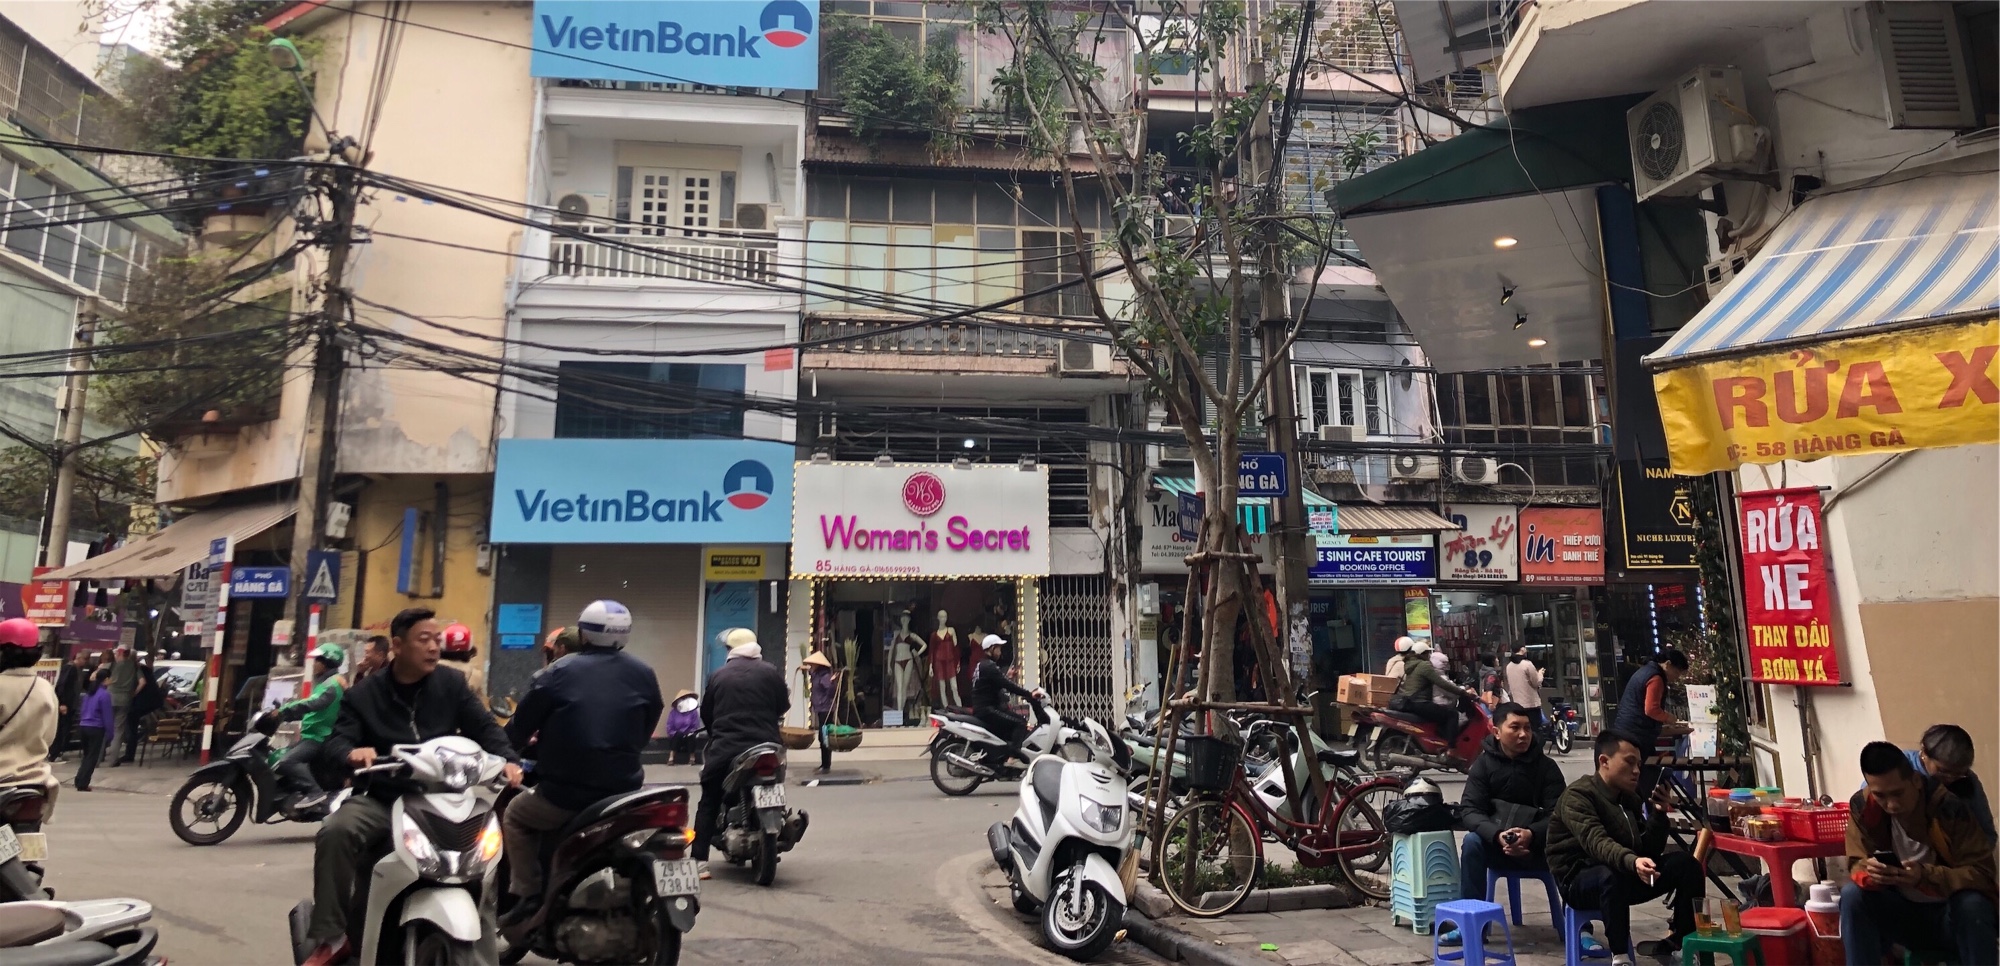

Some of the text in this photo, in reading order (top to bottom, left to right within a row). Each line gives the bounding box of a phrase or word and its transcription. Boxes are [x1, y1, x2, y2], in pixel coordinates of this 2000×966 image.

[541, 14, 762, 59] VietinBank
[1712, 350, 1903, 432] RỬA
[1756, 442, 1786, 456] 58
[1793, 433, 1862, 456] HÀNG
[1869, 427, 1906, 447] GÀ
[1239, 457, 1259, 470] HỐ
[1645, 467, 1675, 479] NAM
[1238, 471, 1280, 490] NG GÀ
[515, 489, 725, 523] VietinBank
[820, 514, 1031, 551] Woman's Secret
[1747, 495, 1818, 554] RỬA
[1526, 524, 1555, 563] in
[1563, 532, 1583, 546] THIẾP
[1636, 534, 1663, 542] NICHE
[1326, 550, 1352, 562] SINH
[1354, 550, 1382, 562] CAFE
[1383, 550, 1426, 562] TOURIST
[1464, 550, 1492, 568] 89
[1563, 550, 1582, 562] DANH
[816, 560, 832, 572] 85
[834, 564, 857, 573] HÀNG
[1339, 563, 1405, 571] BOOKING OFFICE
[1760, 563, 1813, 610] XE
[1752, 625, 1788, 648] THAY
[1761, 654, 1828, 681] BƠM VÁ
[660, 860, 693, 878] 29-C1
